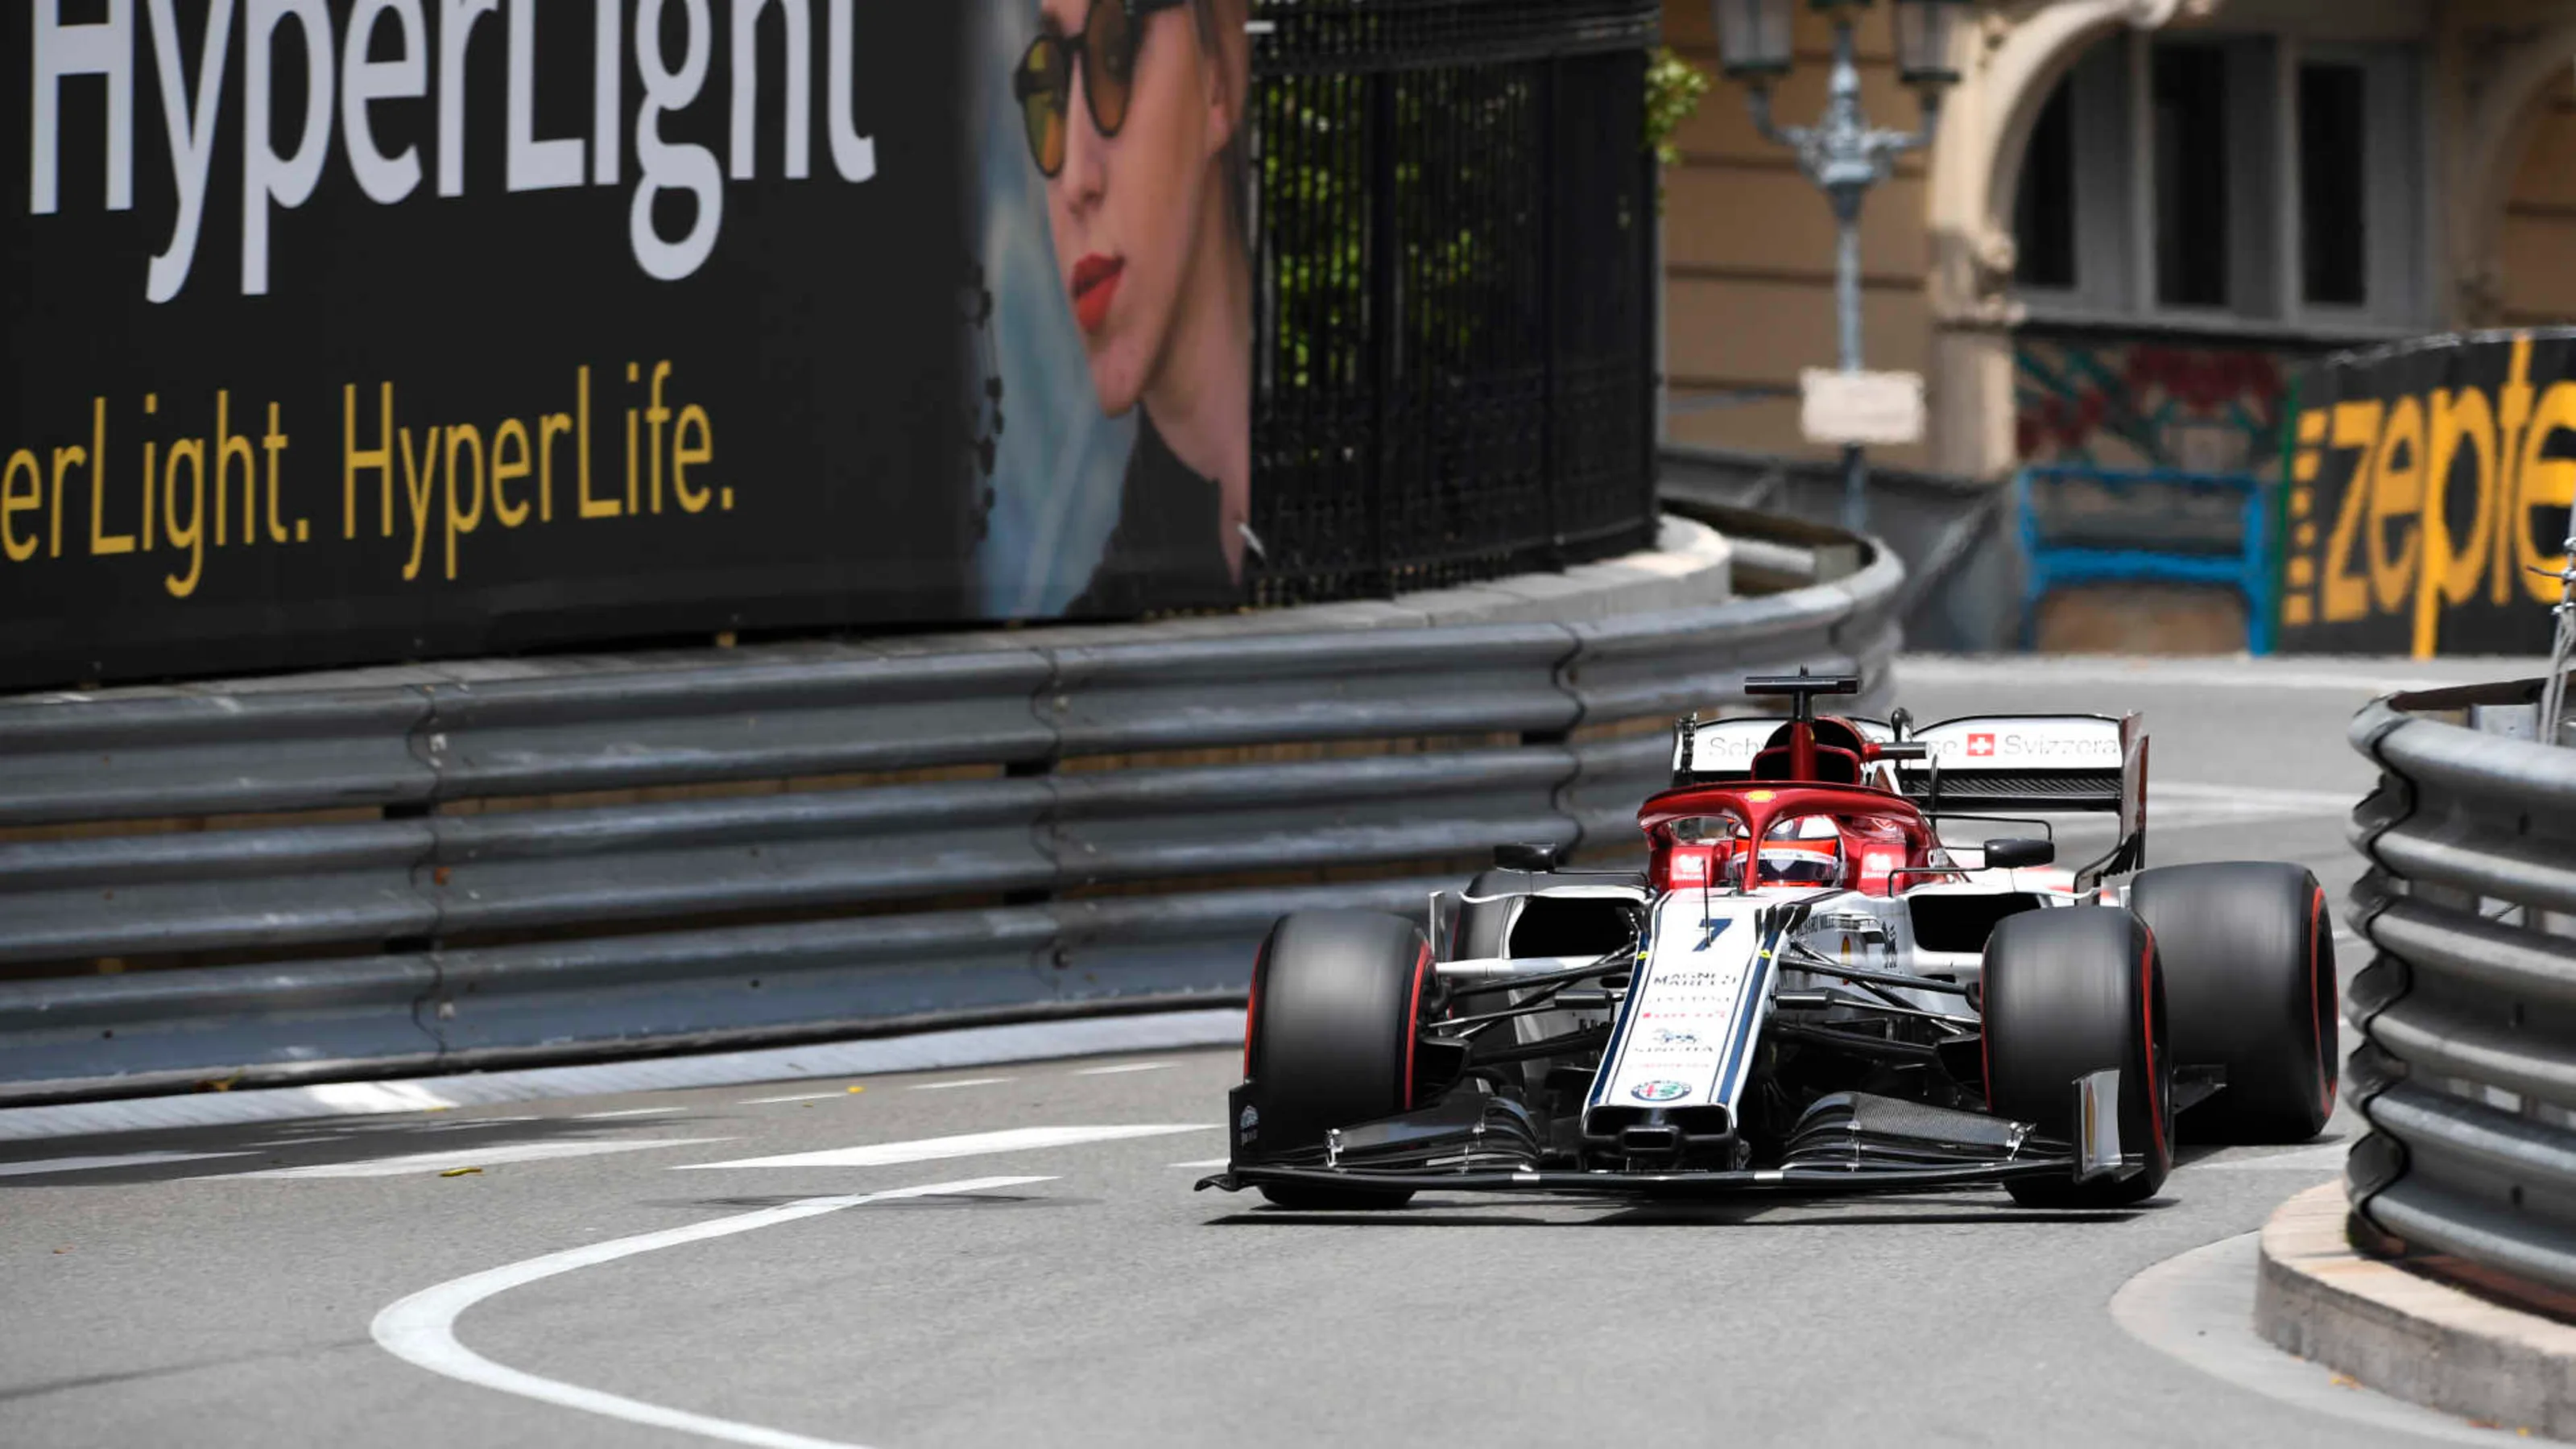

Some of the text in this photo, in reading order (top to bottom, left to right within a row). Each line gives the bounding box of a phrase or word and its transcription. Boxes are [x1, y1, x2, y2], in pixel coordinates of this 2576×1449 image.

[30, 0, 877, 303] HyperLight
[0, 361, 734, 597] erLight. HyperLife.
[1708, 736, 1765, 757] Sch
[2003, 734, 2118, 756] Svizzera
[1692, 918, 1734, 952] 7
